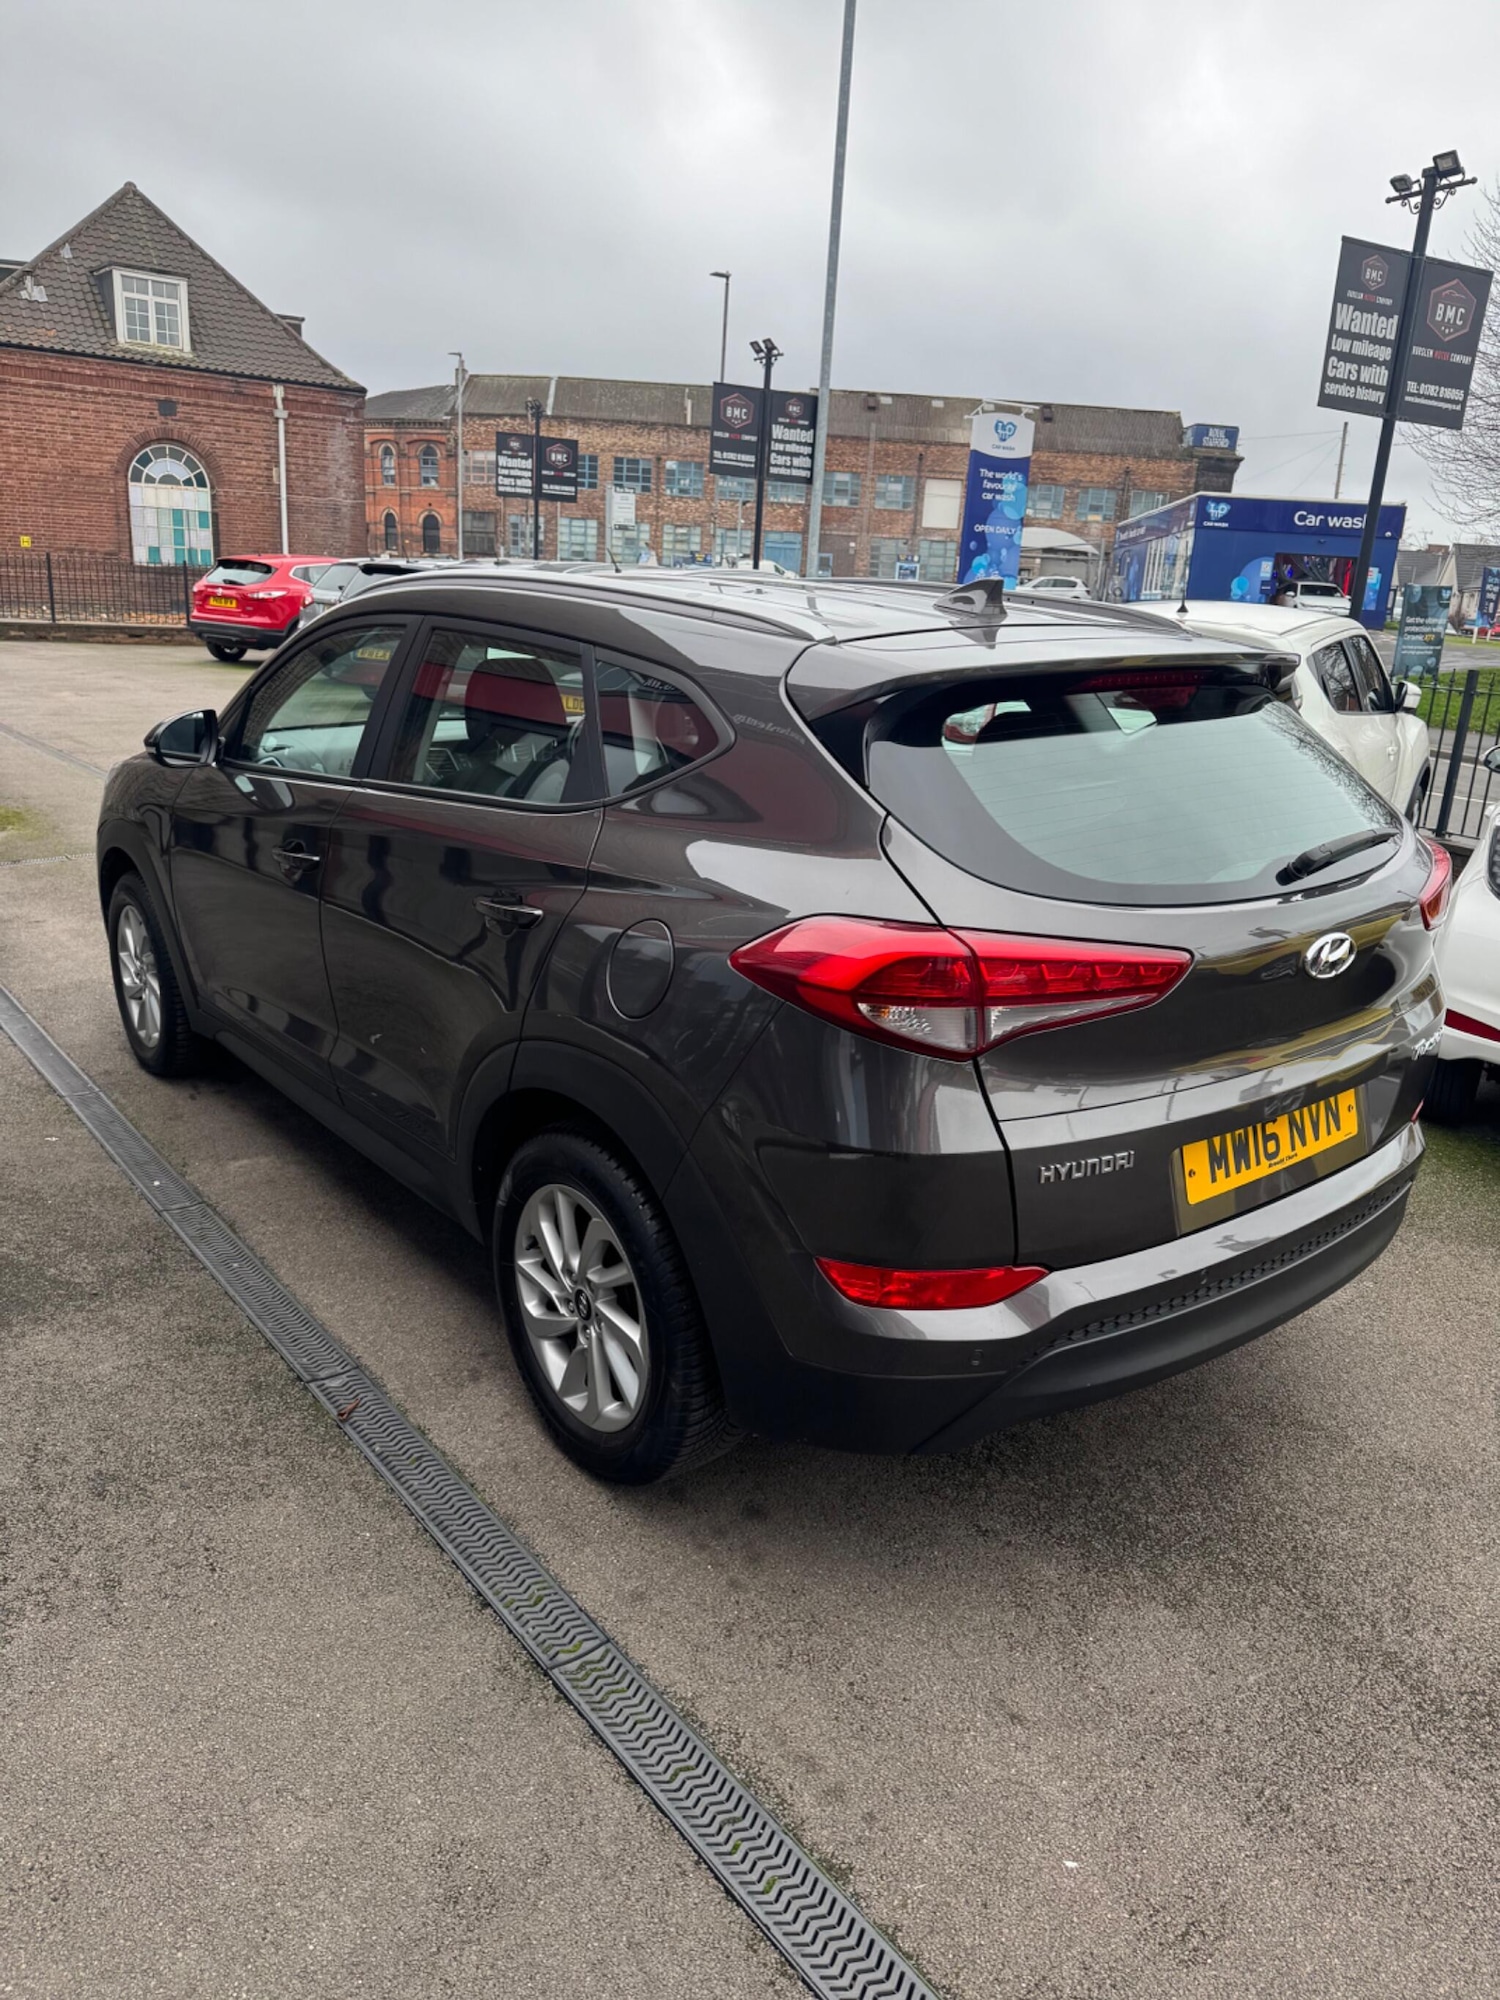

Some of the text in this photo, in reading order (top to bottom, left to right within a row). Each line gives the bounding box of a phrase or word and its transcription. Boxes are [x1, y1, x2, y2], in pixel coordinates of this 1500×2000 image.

[1365, 268, 1383, 282] BMC
[1335, 302, 1399, 340] Wanted
[1435, 303, 1466, 326] BMC
[1331, 334, 1392, 361] Low mileage
[1327, 356, 1389, 387] Cars with
[1324, 382, 1355, 398] service
[1355, 387, 1386, 404] history
[726, 406, 748, 419] BMC
[772, 424, 814, 443] Wanted
[771, 441, 812, 455] Low mileage
[498, 455, 532, 469] Wanted
[770, 452, 791, 466] Cars
[792, 455, 812, 468] with
[979, 468, 994, 478] The
[981, 492, 994, 500] car
[1293, 511, 1324, 527] Car
[974, 524, 1016, 535] OPEN DAILY
[1207, 1094, 1341, 1184] MW16 NVN
[1039, 1150, 1135, 1184] HYUNDAI
